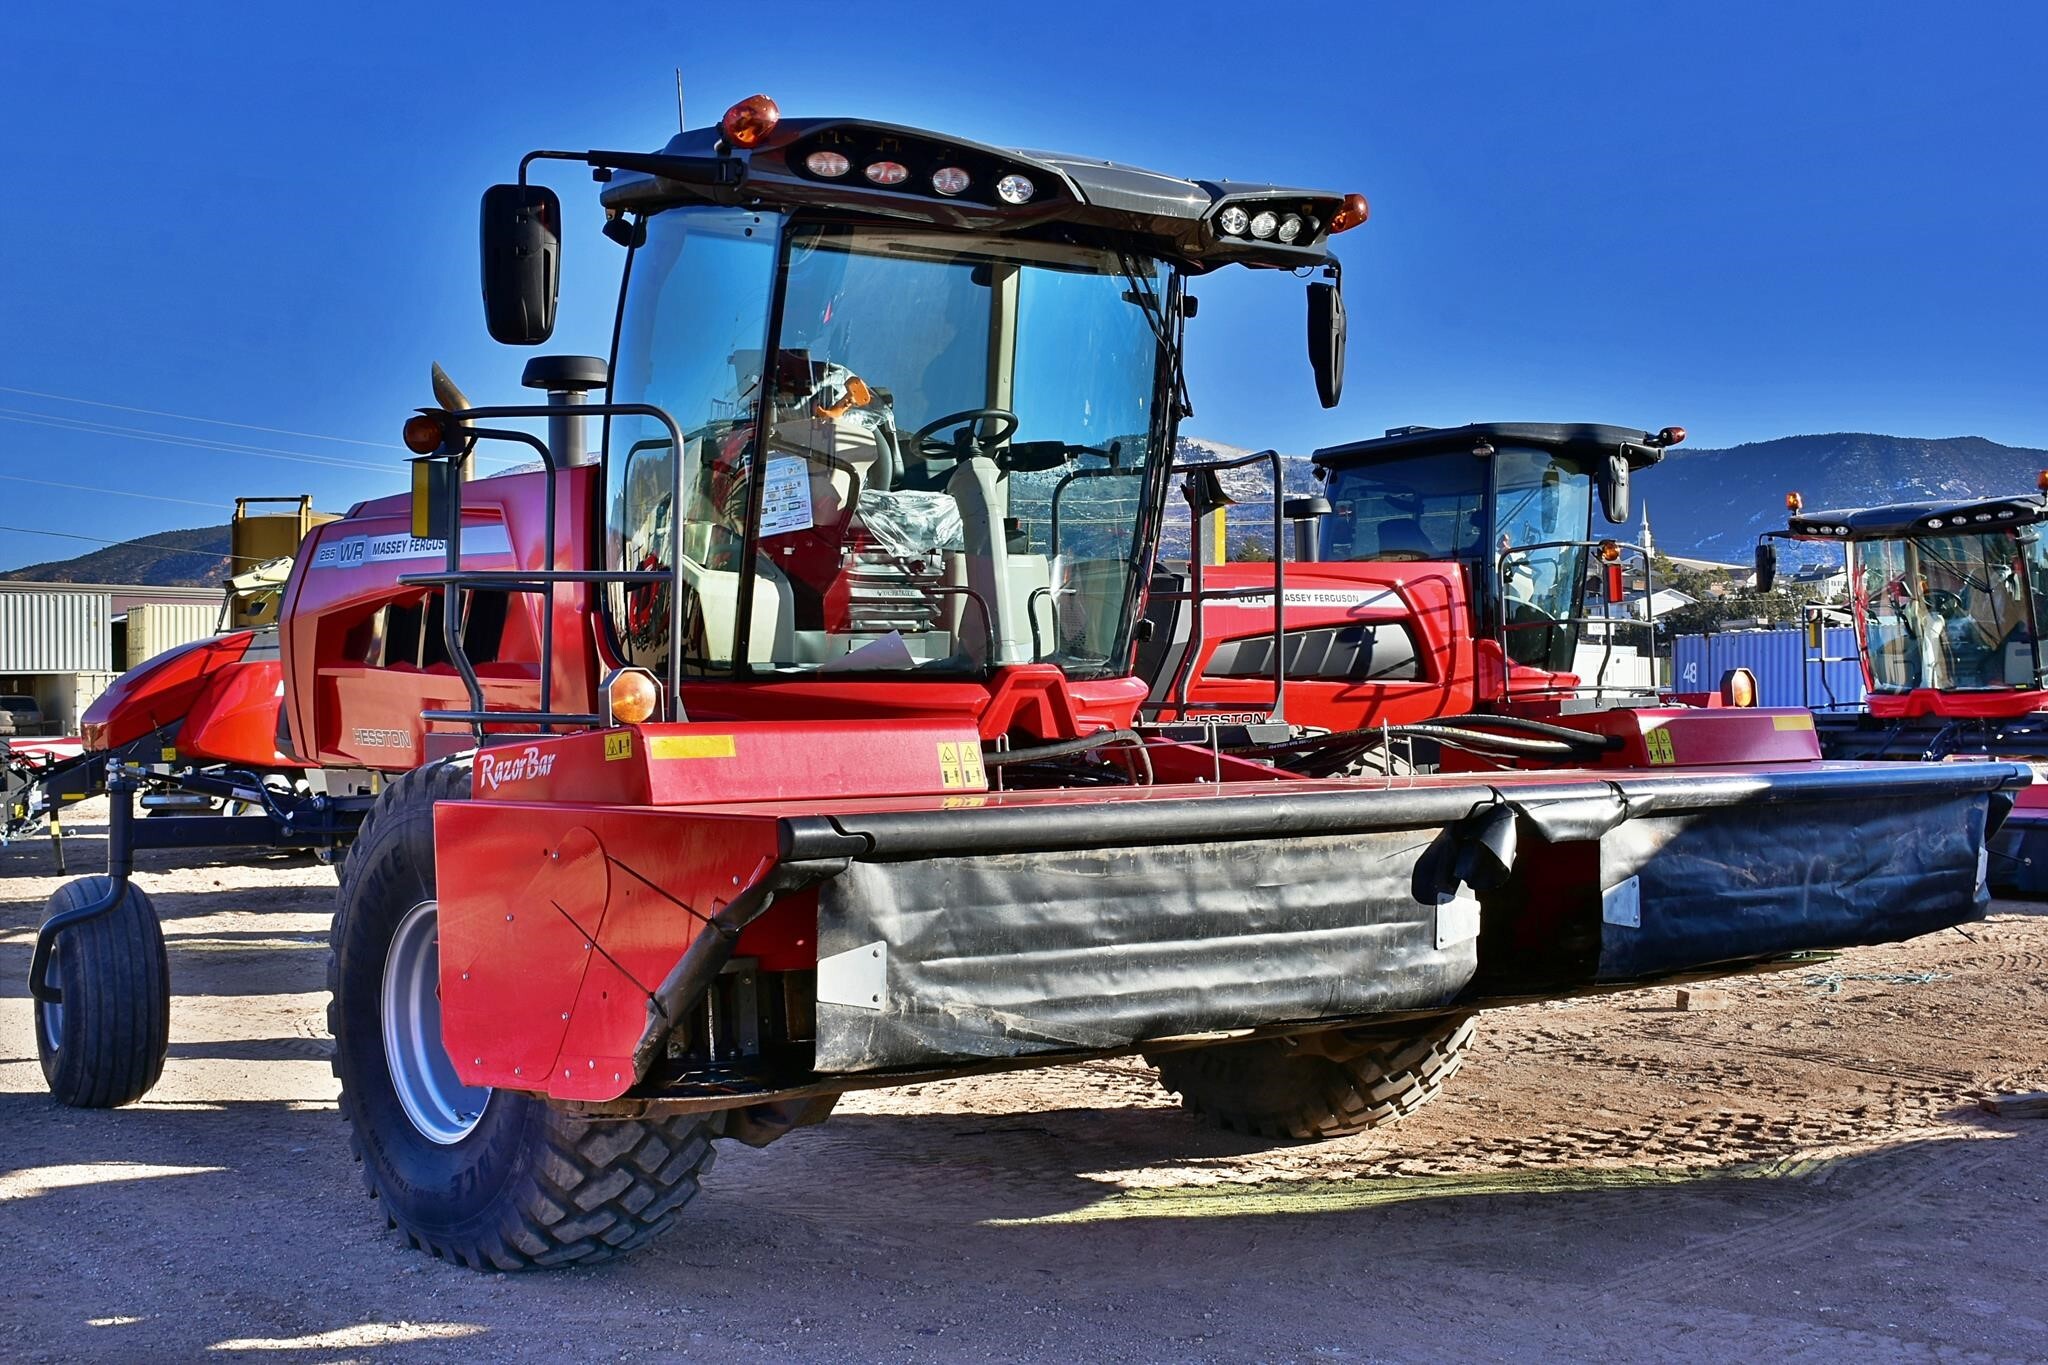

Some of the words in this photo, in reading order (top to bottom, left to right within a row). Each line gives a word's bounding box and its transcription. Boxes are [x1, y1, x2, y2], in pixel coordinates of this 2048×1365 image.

[319, 547, 335, 561] 265
[340, 541, 365, 562] WR
[372, 539, 408, 556] MASSEY
[408, 538, 447, 553] FERGUS
[1284, 593, 1312, 602] ASSEY
[1314, 593, 1359, 603] FERGUSON
[1683, 662, 1697, 684] 48
[352, 728, 412, 748] HESSTON
